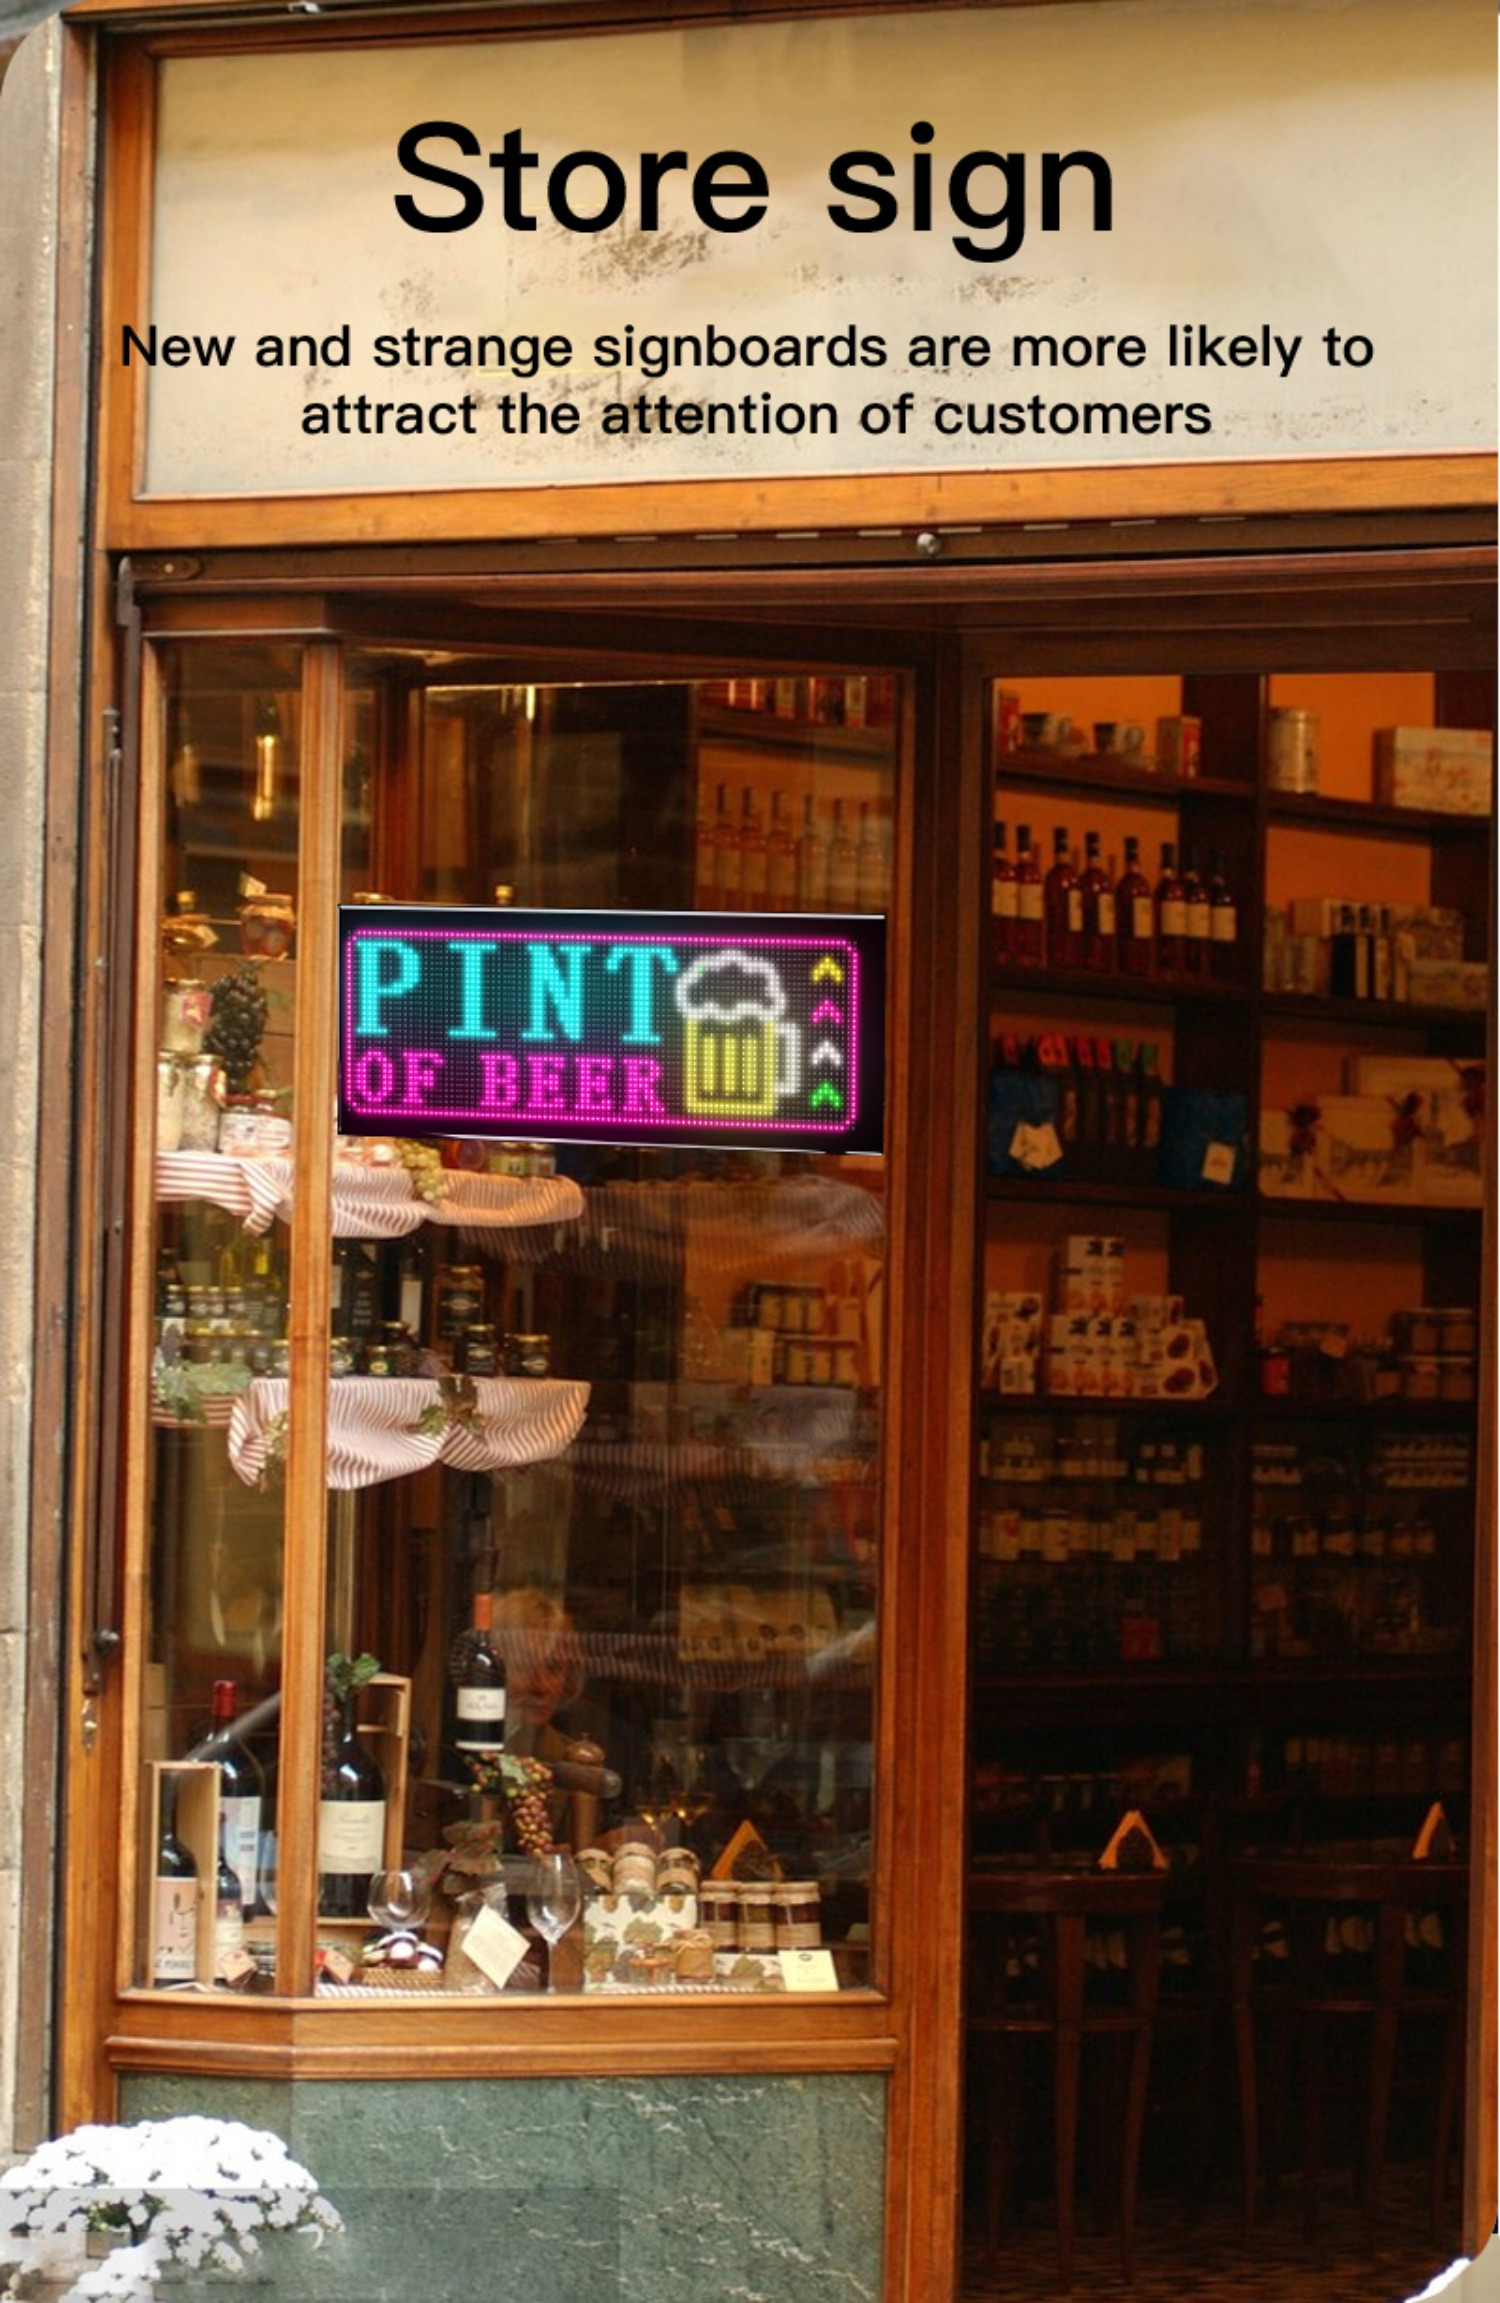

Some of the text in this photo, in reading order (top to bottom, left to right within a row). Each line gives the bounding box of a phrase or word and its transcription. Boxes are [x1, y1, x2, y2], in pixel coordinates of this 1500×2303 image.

[354, 938, 679, 1044] PINT
[353, 1049, 665, 1113] OF BEER
